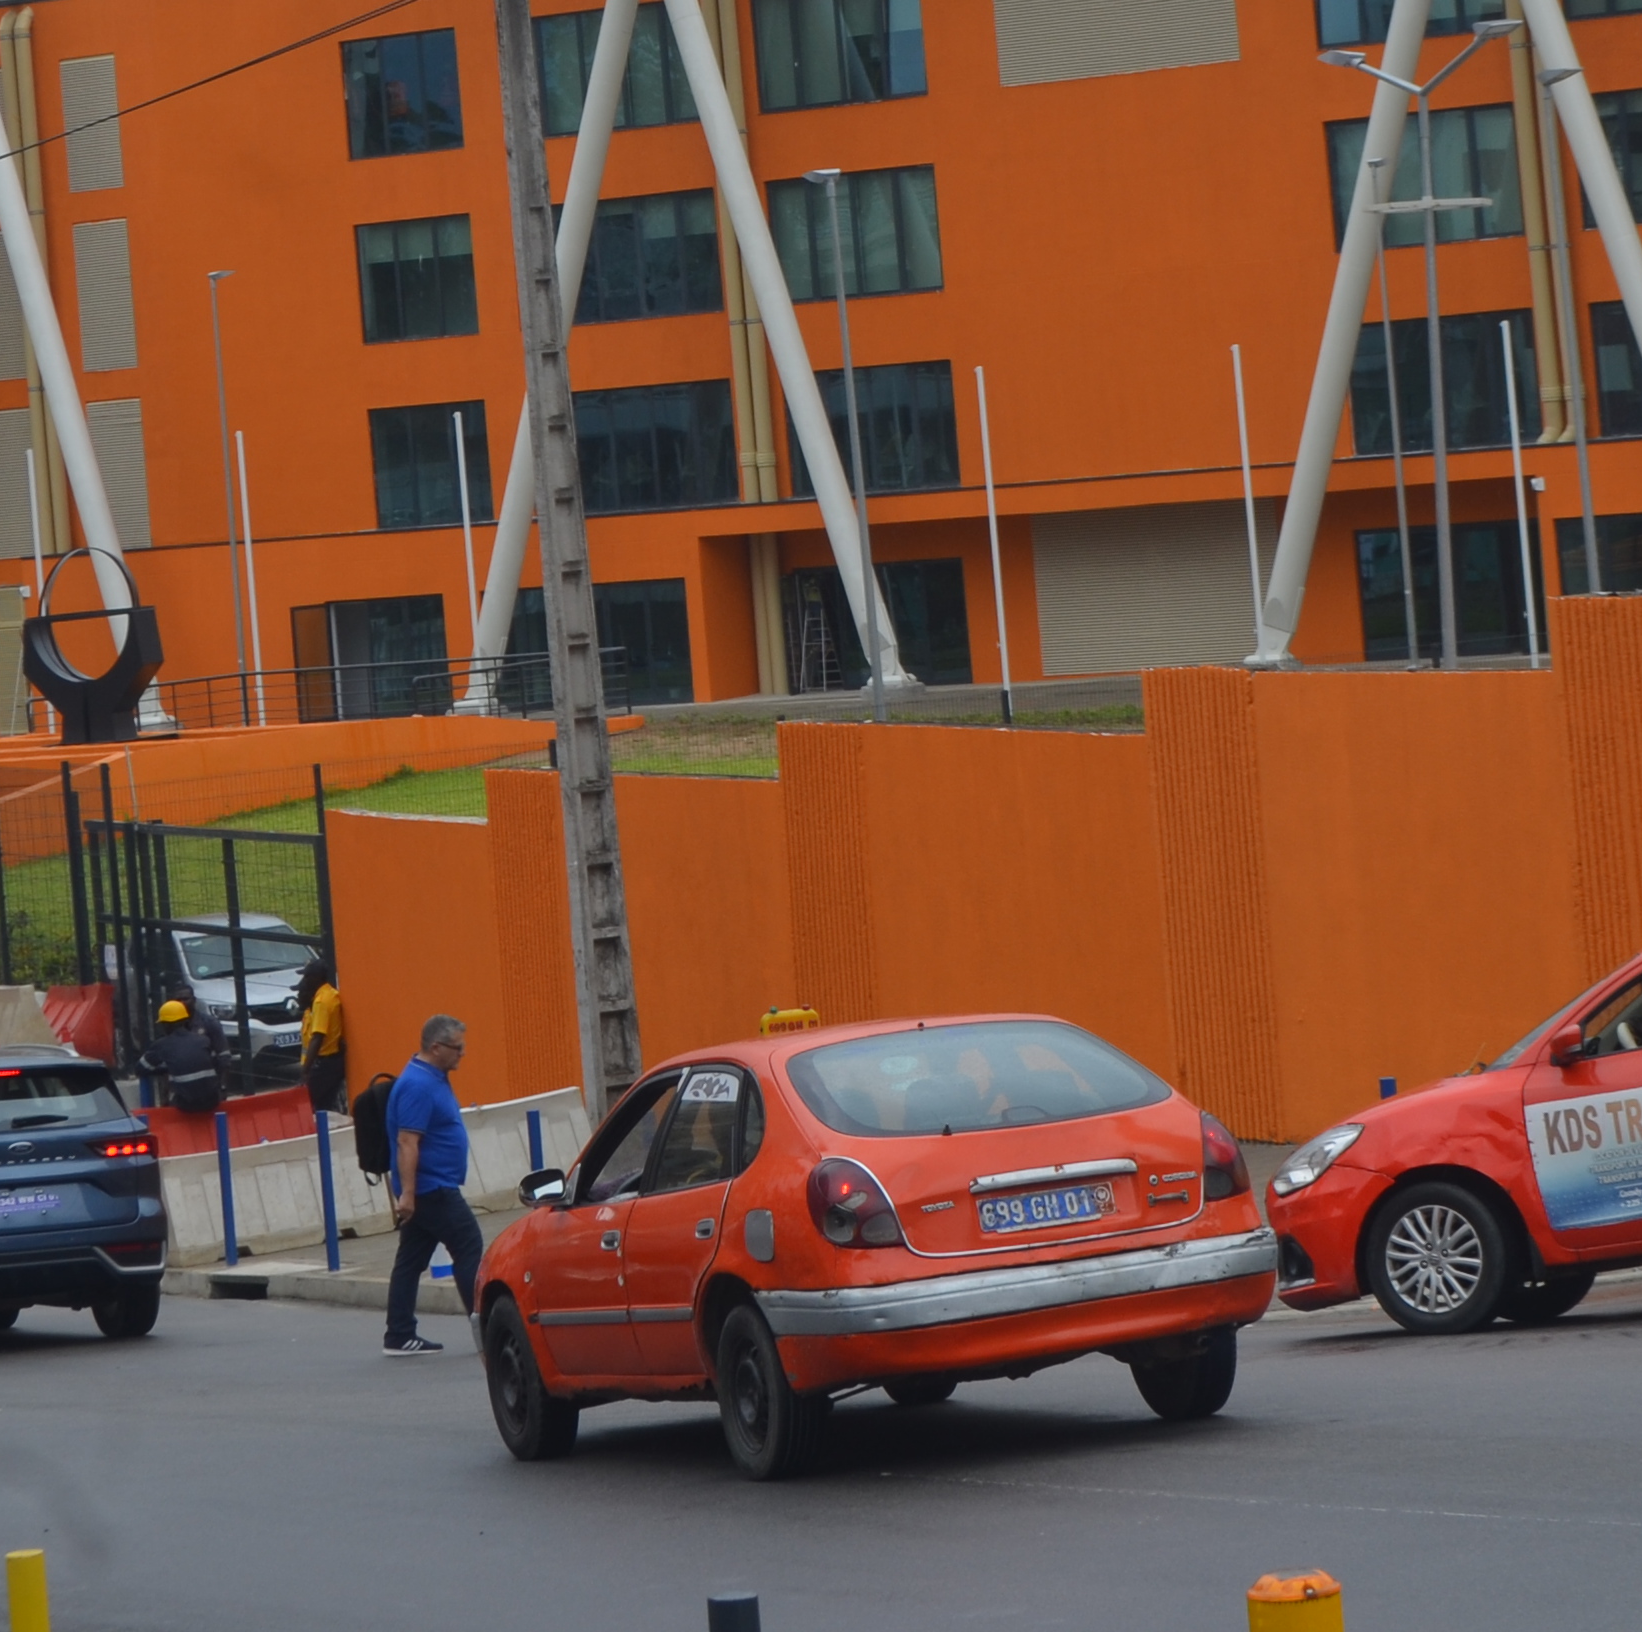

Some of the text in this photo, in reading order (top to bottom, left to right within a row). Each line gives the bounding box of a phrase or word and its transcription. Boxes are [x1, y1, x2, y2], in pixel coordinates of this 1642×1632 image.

[1543, 1104, 1603, 1155] KDS
[921, 1200, 955, 1213] TOYOTA
[981, 1189, 1092, 1227] 699 GH 01
